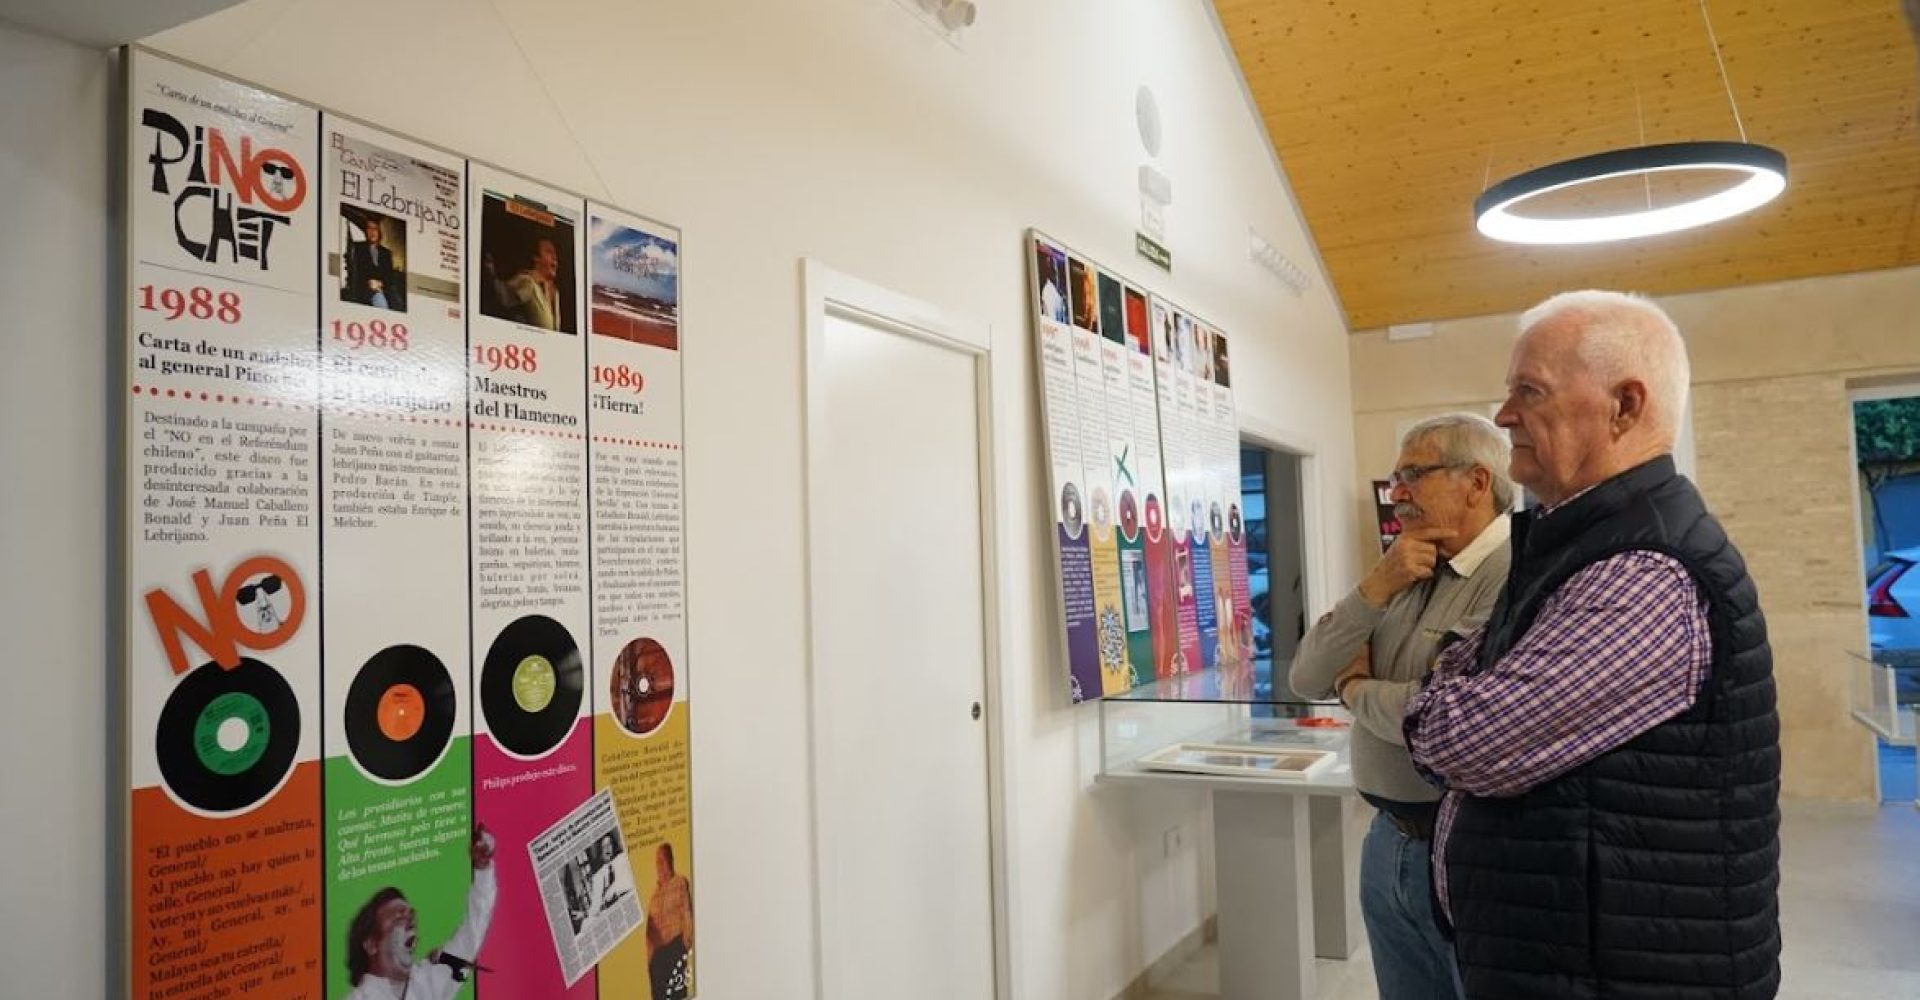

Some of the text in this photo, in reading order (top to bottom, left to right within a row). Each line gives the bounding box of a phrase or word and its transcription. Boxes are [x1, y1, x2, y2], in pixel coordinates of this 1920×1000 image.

[340, 168, 361, 201] El
[367, 177, 461, 233] Lebrijano
[174, 185, 292, 271] CHET
[139, 284, 242, 325] 1988
[138, 331, 191, 353] Carta
[195, 339, 217, 356] de
[223, 348, 245, 361] un
[330, 318, 409, 351] 1988
[138, 354, 156, 369] al
[161, 360, 230, 379] general
[473, 343, 537, 373] 1988
[474, 375, 548, 401] Maestros
[592, 364, 645, 394] 1989
[474, 399, 578, 427] del Flamenco
[593, 394, 644, 415] ¡Tierra!
[143, 410, 308, 438] Destinado a la campaña por
[143, 428, 155, 440] el
[199, 434, 213, 445] en
[221, 433, 232, 446] el
[239, 436, 309, 452] Referéndum
[332, 443, 357, 456] Juan
[214, 450, 241, 463] este
[250, 452, 282, 466] disco
[290, 454, 309, 466] fue
[143, 463, 308, 482] producido gracias a la
[333, 472, 367, 485] Pedro
[143, 478, 309, 497] desinteresada colaboración
[333, 487, 395, 501] producción
[143, 494, 309, 513] de José Manuel Caballero
[143, 512, 309, 529] Bonald y Juan Peña El
[143, 528, 209, 544] Lebrijano.
[144, 556, 306, 677] NO
[176, 836, 220, 859] pueblo
[224, 833, 242, 845] no
[170, 872, 215, 894] pueblo
[220, 867, 237, 880] no
[241, 861, 262, 876] hay
[267, 852, 301, 870] quien
